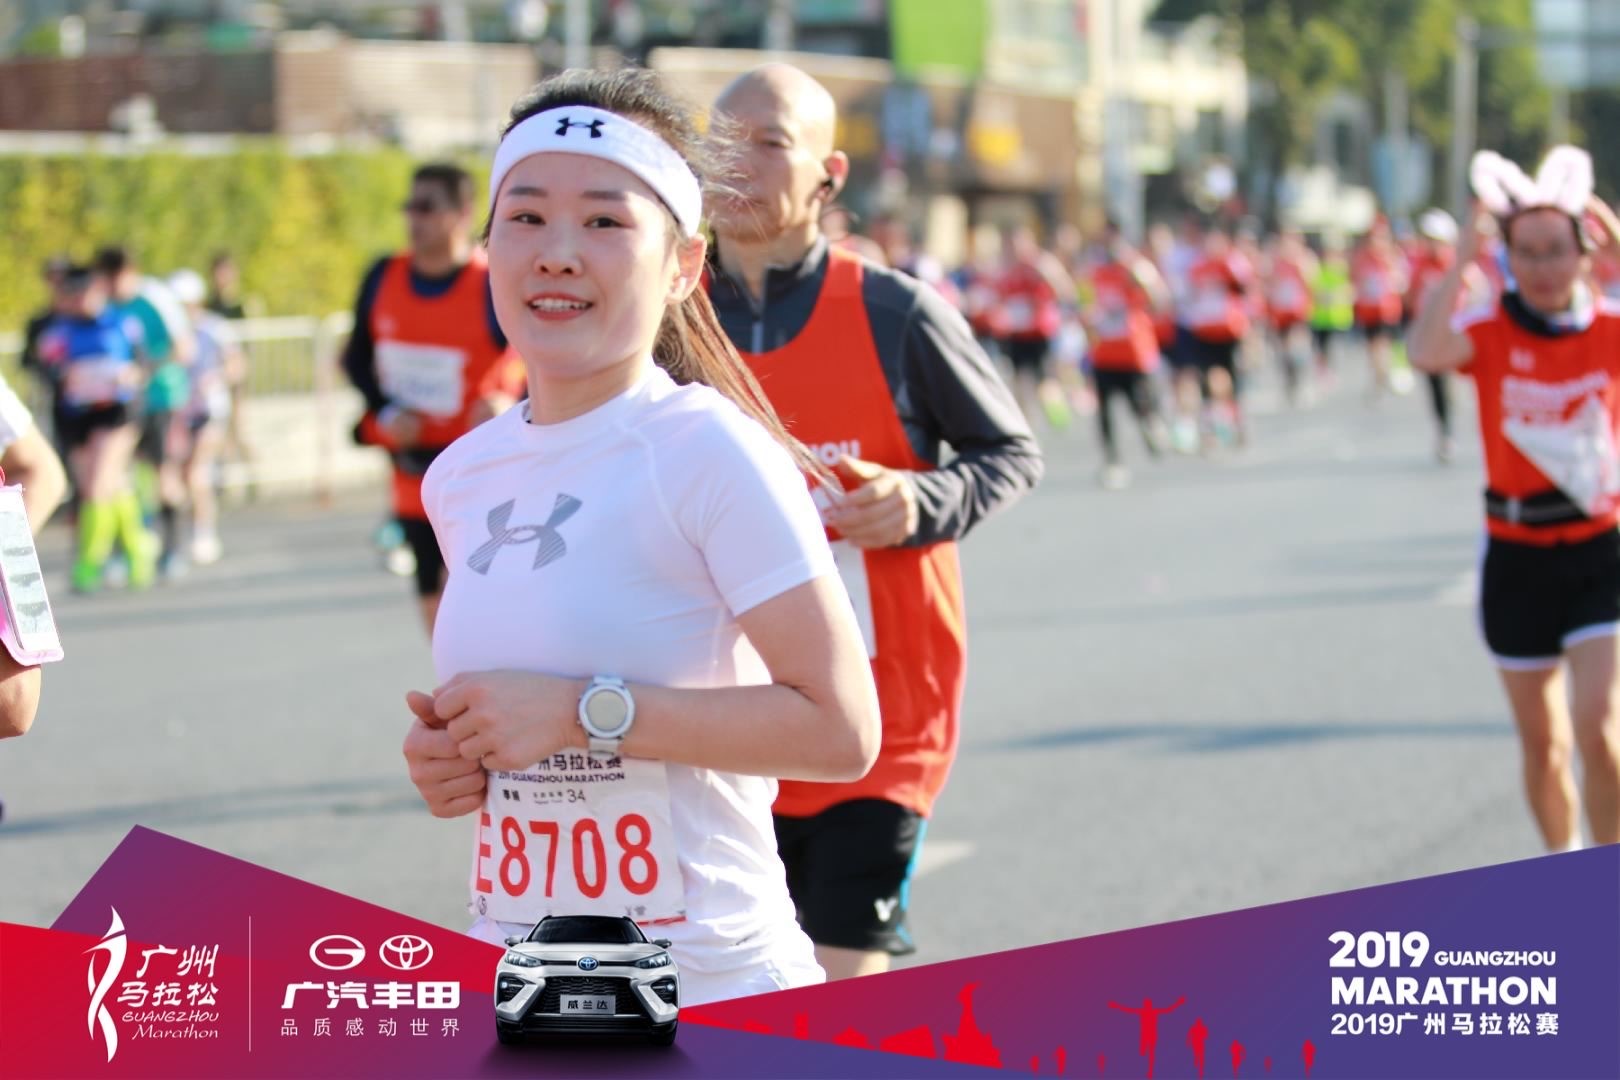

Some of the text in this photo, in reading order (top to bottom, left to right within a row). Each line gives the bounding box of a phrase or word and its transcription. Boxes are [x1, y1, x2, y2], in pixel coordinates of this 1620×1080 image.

[512, 772, 563, 783] GUANGZHOU
[565, 772, 625, 783] MARATHON
[567, 788, 586, 803] 34
[476, 813, 658, 898] E8708
